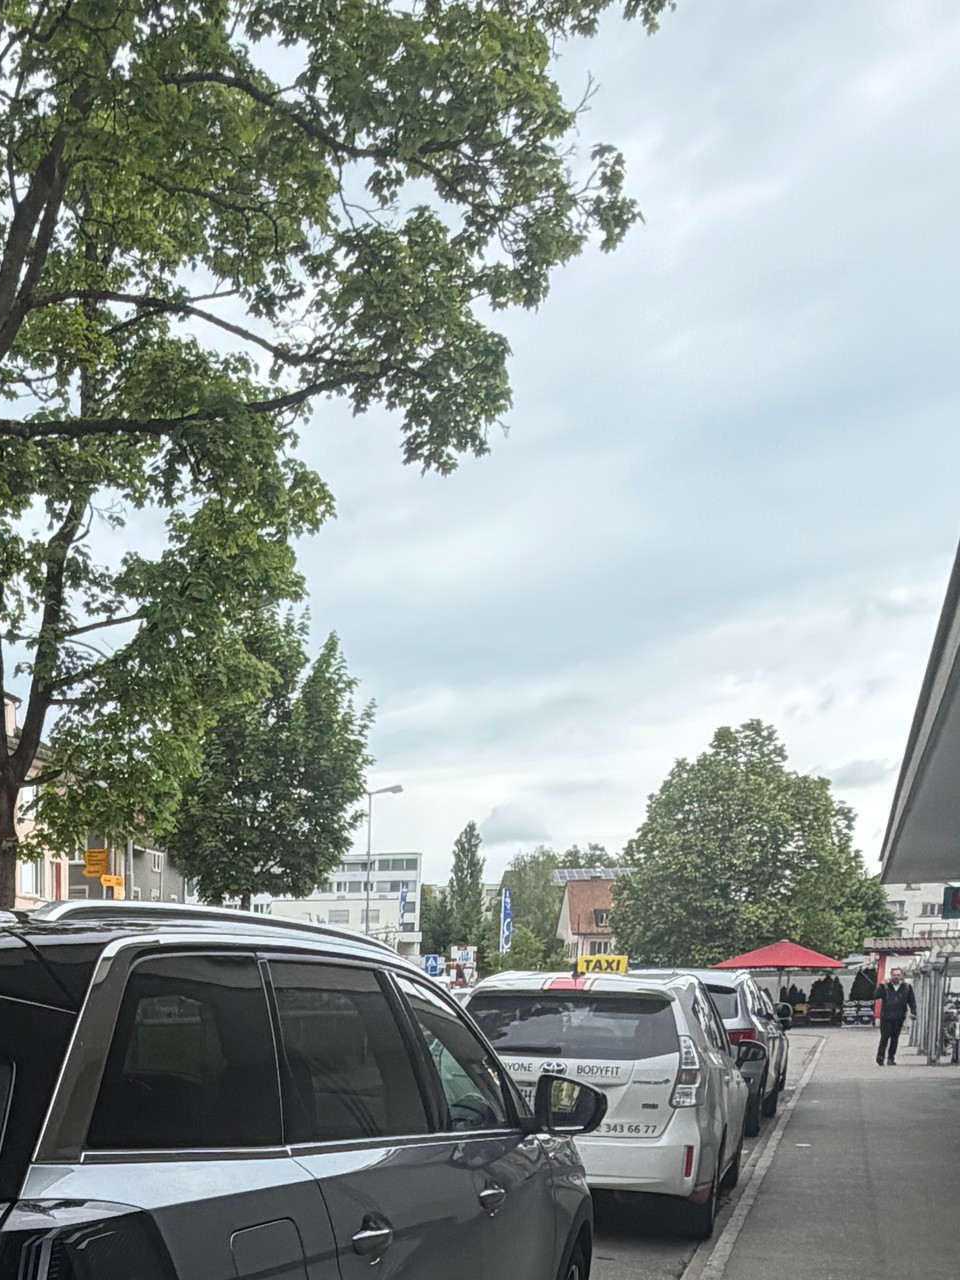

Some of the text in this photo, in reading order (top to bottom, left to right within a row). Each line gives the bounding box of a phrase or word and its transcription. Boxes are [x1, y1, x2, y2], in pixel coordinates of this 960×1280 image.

[583, 959, 622, 972] TAXI
[576, 1065, 622, 1077] BODYFIT
[605, 1124, 624, 1134] 343
[627, 1125, 640, 1134] 66
[644, 1126, 657, 1134] 77
